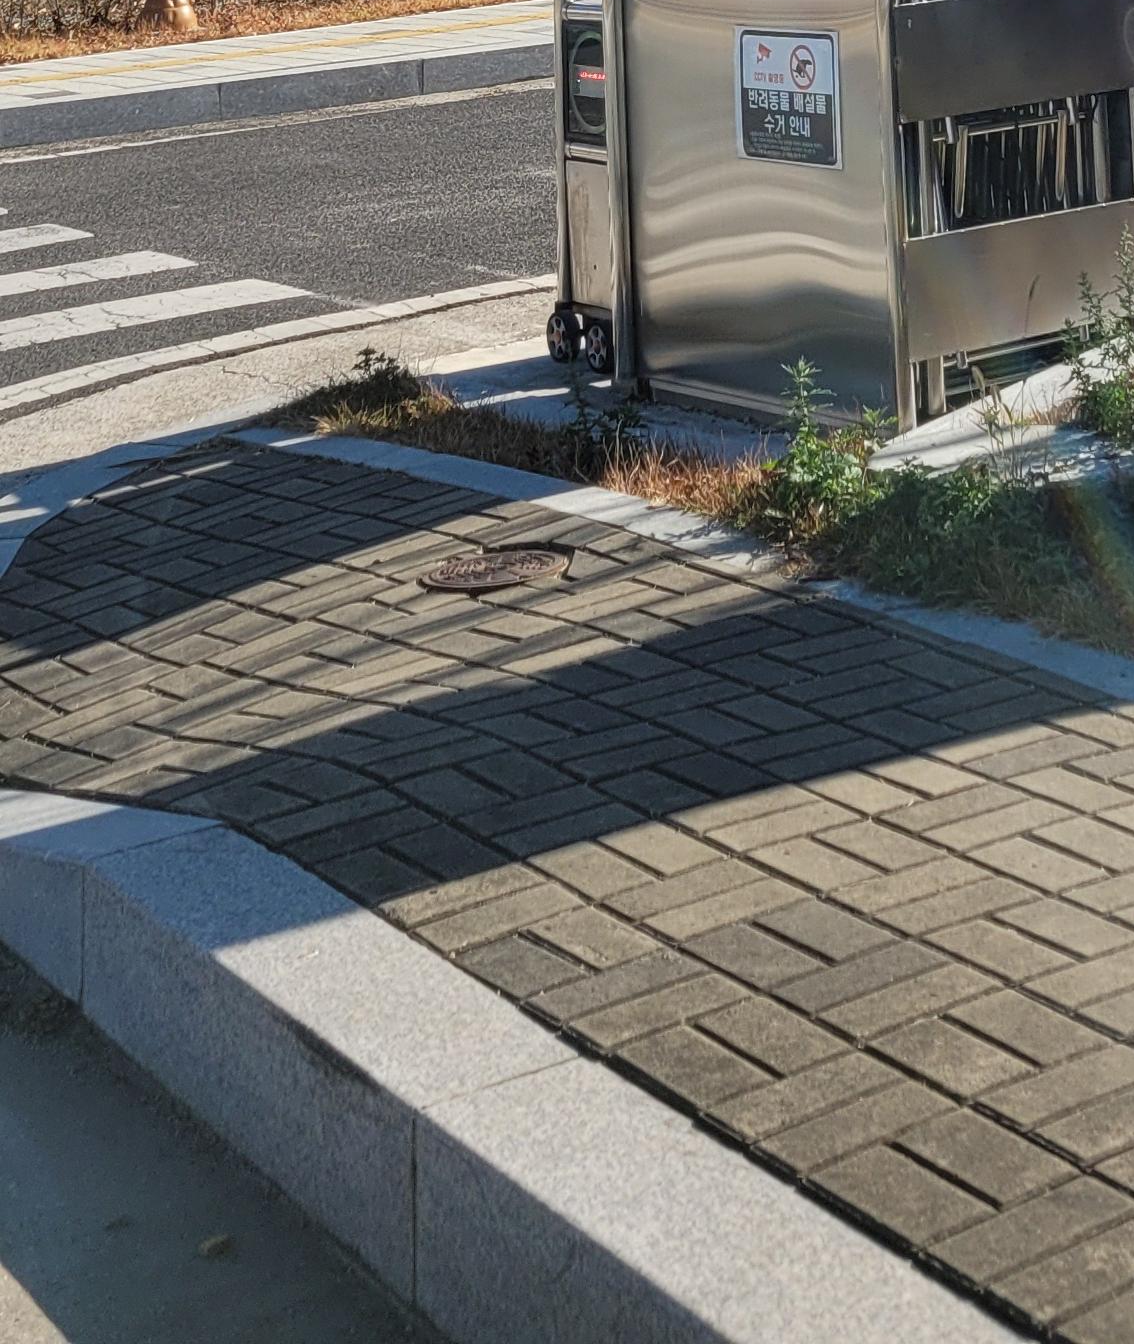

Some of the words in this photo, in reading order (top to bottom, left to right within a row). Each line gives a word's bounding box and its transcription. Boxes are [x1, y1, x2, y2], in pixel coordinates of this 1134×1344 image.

[748, 88, 790, 112] 반려동물
[793, 93, 827, 114] 배설물
[764, 114, 786, 136] 수거
[789, 116, 811, 138] 안내
